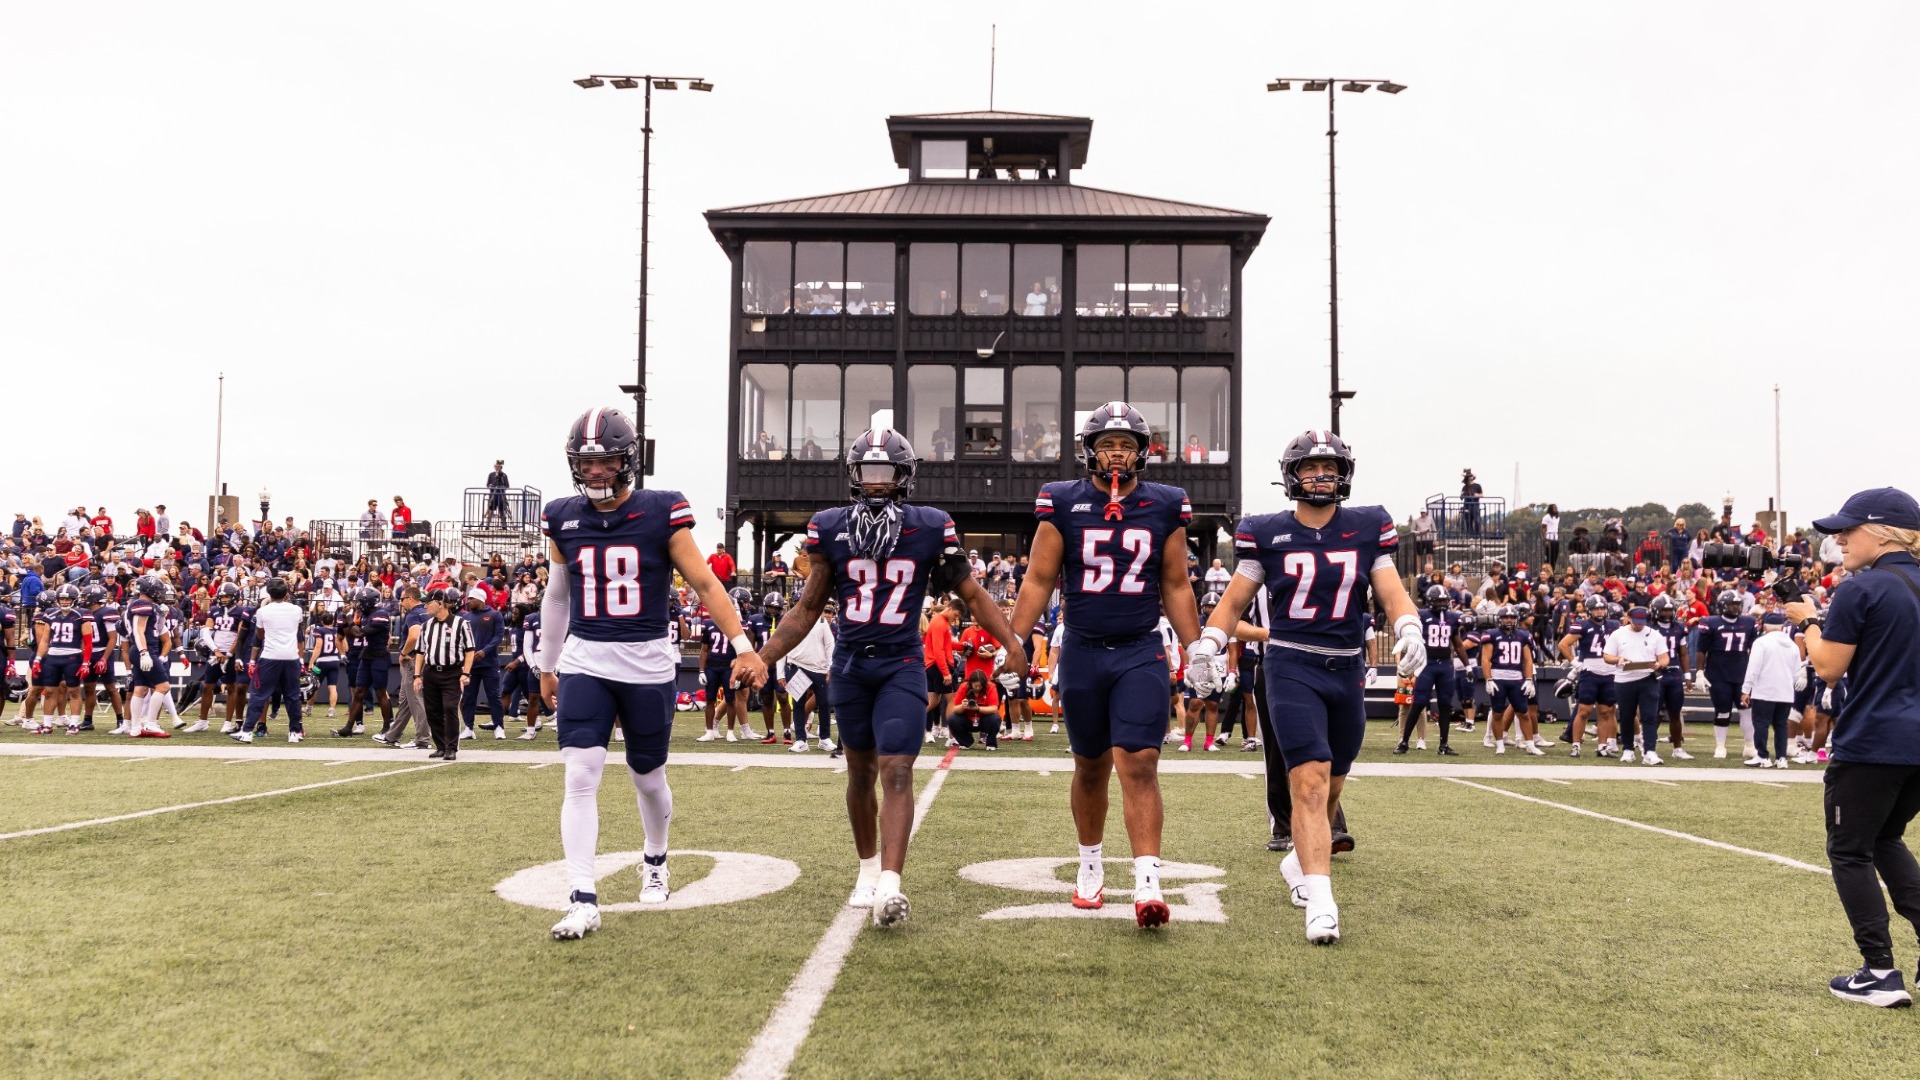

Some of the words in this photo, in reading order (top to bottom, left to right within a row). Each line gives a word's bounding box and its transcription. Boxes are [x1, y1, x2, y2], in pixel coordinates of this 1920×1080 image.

[1081, 528, 1152, 594] 52
[576, 545, 642, 618] 18
[845, 558, 916, 626] 32
[1284, 550, 1358, 620] 27
[51, 622, 74, 643] 29
[711, 632, 729, 654] 21
[1428, 624, 1451, 647] 88
[1722, 632, 1746, 652] 77
[1498, 641, 1522, 664] 30
